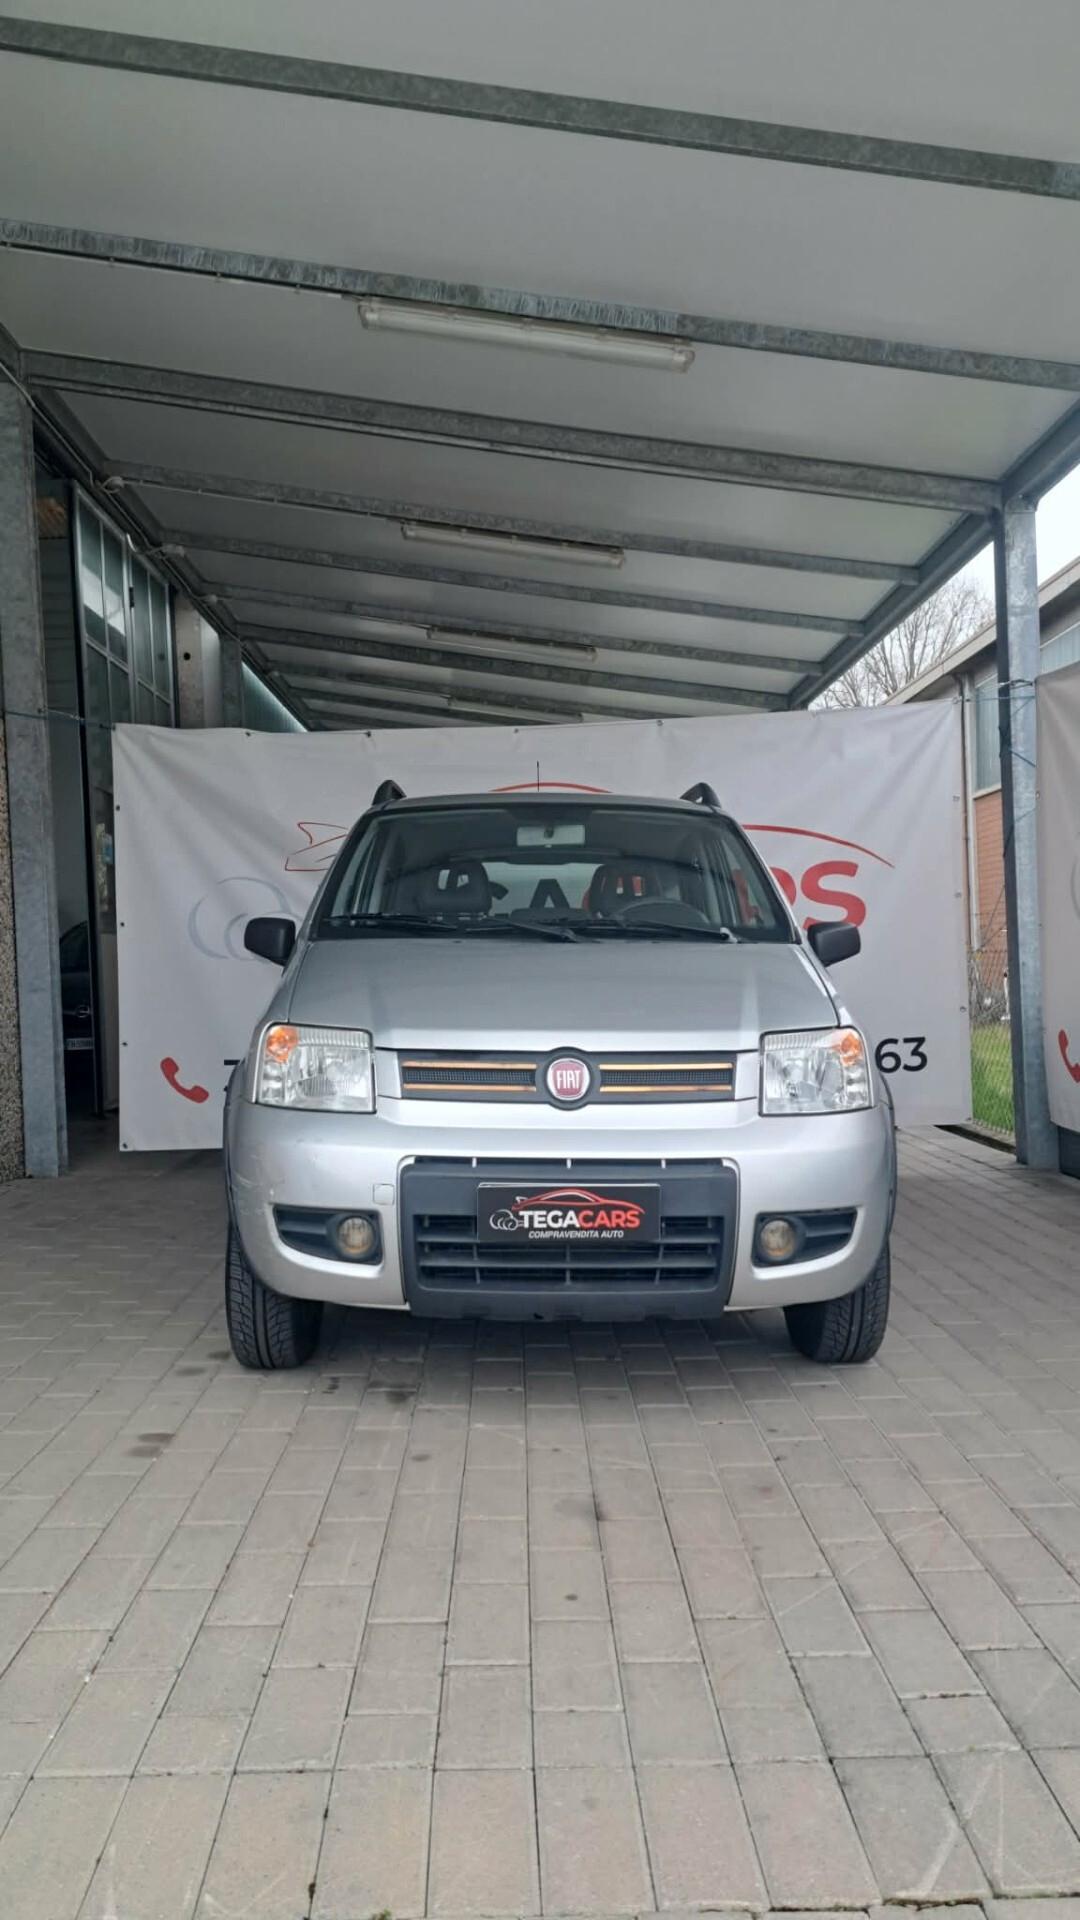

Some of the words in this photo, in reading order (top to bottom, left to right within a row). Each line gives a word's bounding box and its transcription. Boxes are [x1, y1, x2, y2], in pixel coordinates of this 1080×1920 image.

[556, 1069, 581, 1089] FIAT
[519, 1210, 641, 1229] TEGACARS
[528, 1230, 599, 1239] COMPRAVENDITA
[601, 1230, 624, 1239] AUTO
